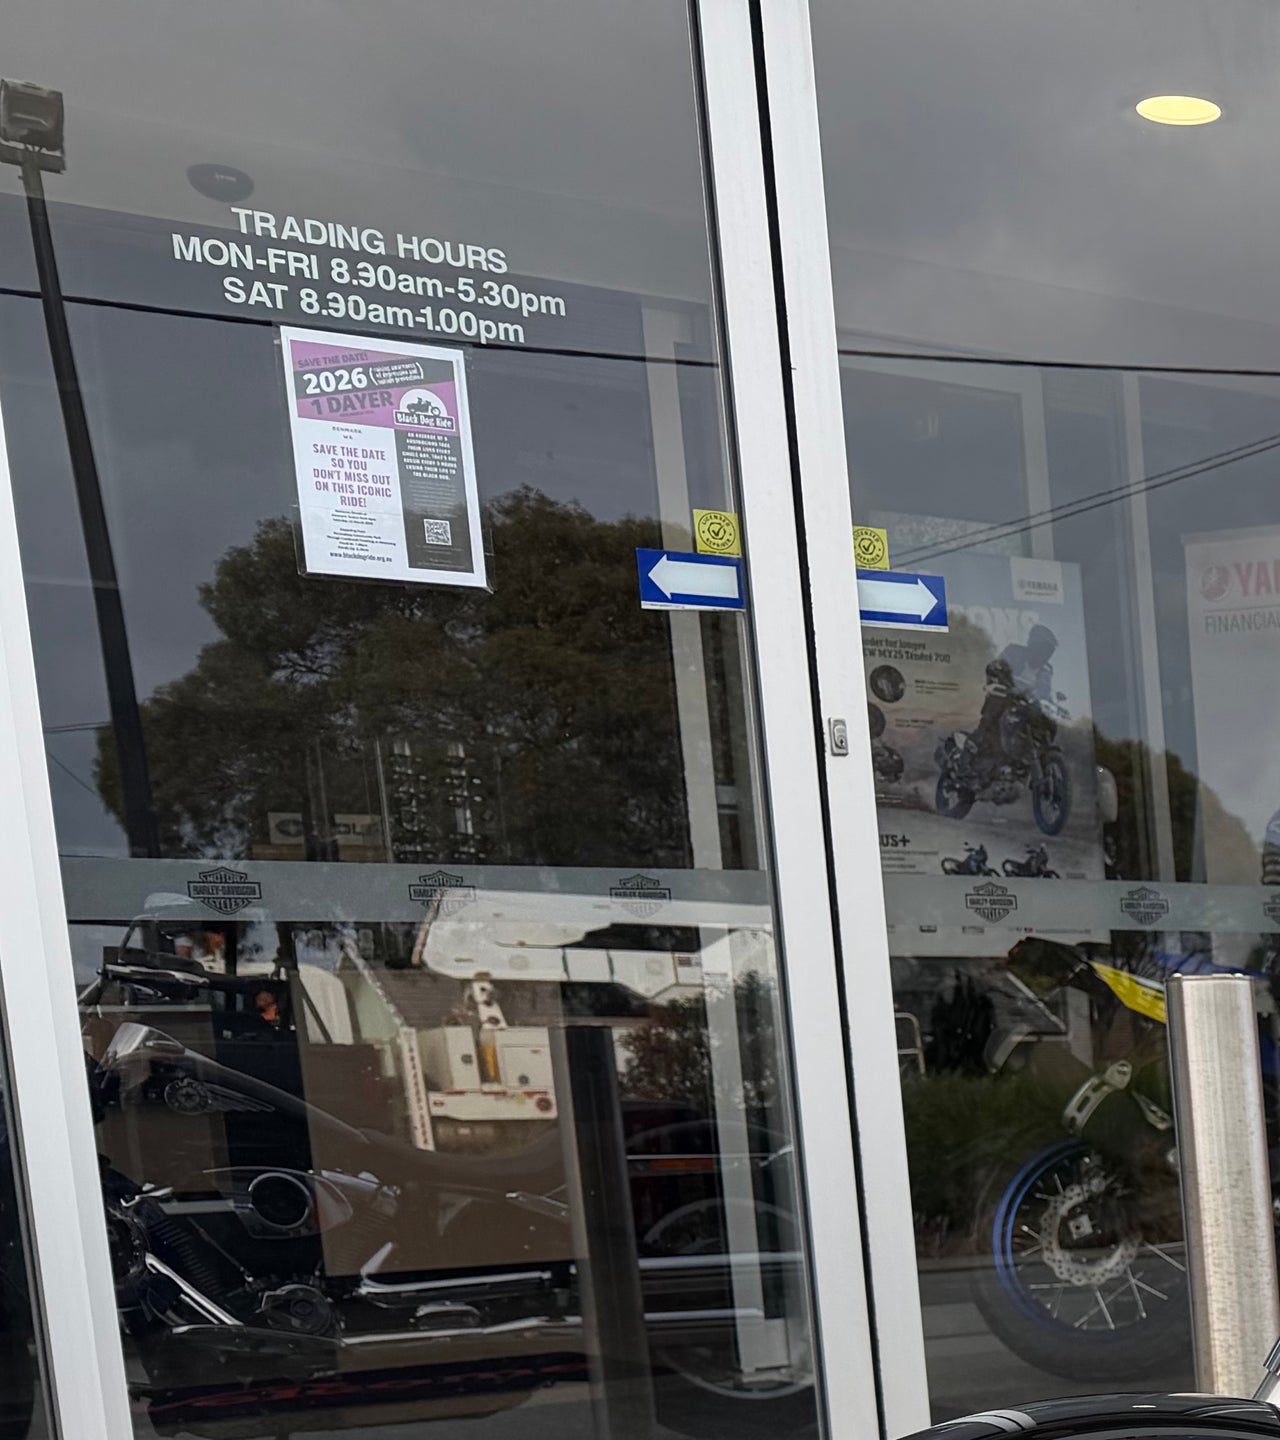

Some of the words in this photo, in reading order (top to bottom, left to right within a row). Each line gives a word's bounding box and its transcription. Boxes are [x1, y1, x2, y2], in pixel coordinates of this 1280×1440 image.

[231, 207, 386, 255] TRADING
[397, 233, 508, 274] HOURS
[171, 233, 319, 280] MON-FRI
[223, 276, 288, 310] SAT
[298, 358, 322, 368] SAVE
[323, 355, 340, 364] THE
[303, 368, 368, 394] 2026
[311, 399, 322, 415] 1
[328, 391, 394, 413] DAYER
[397, 413, 417, 424] Black
[420, 415, 435, 427] Dog
[436, 416, 452, 428] Ride
[313, 443, 337, 455] SAVE
[341, 446, 359, 457] THE
[362, 449, 386, 460] DATE
[331, 458, 344, 468] SO
[347, 460, 367, 471] YOU
[313, 468, 340, 480] DON'T
[345, 471, 369, 483] MISS
[371, 475, 390, 485] OUT
[315, 481, 329, 491] ON
[332, 482, 354, 494] THIS
[358, 485, 392, 497] ICONIC
[340, 496, 367, 507] RIDE!
